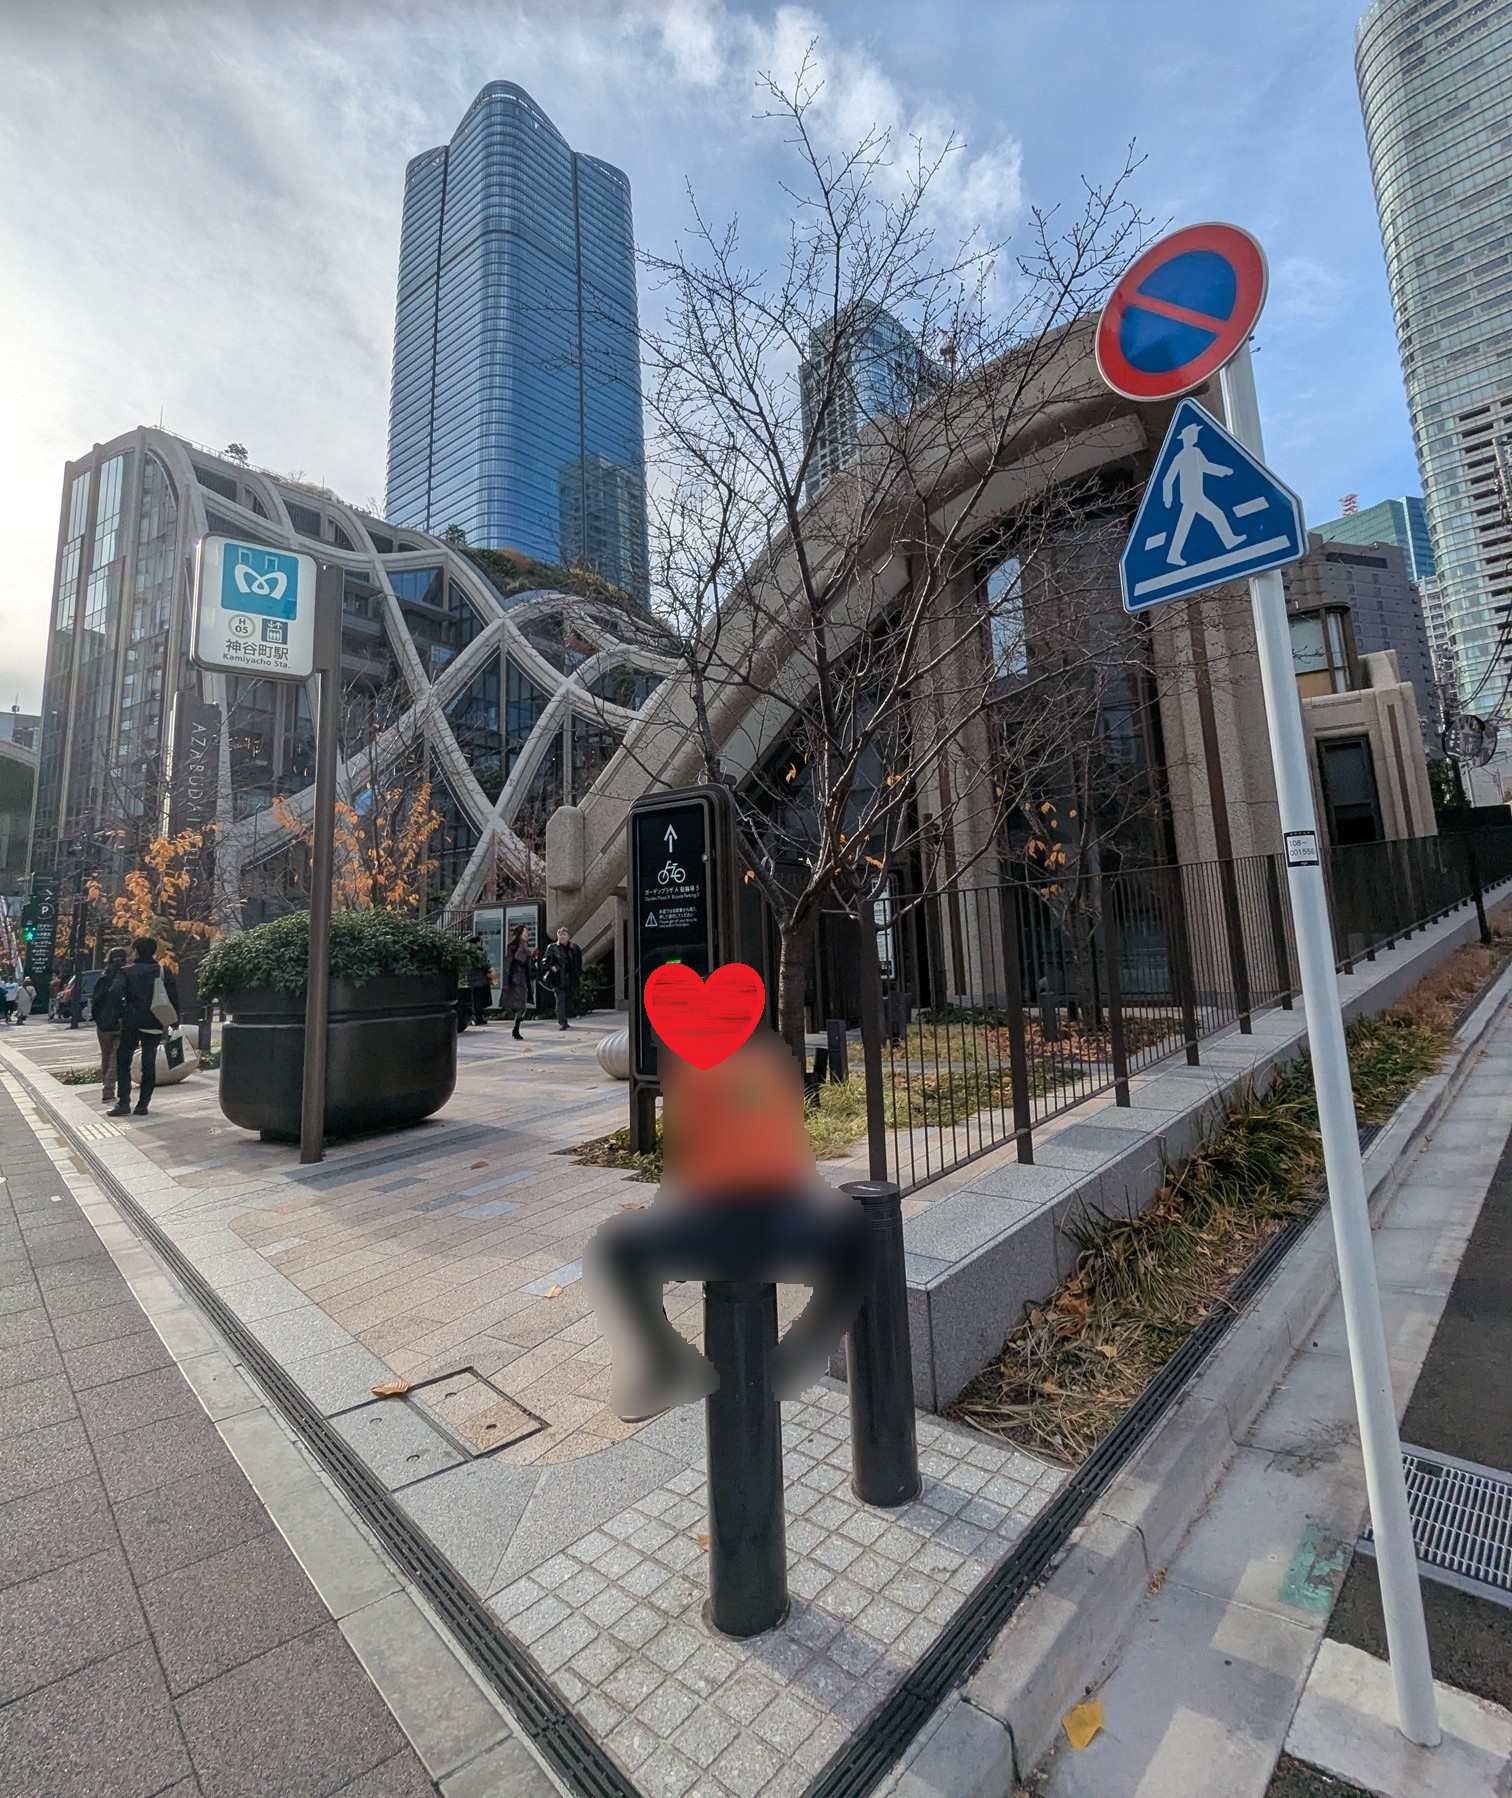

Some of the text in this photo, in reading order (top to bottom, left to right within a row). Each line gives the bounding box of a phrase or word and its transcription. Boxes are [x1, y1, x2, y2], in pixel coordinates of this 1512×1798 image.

[238, 618, 246, 626] H
[234, 625, 248, 634] 05
[225, 639, 289, 661] 神谷町駅
[223, 653, 291, 669] Kamiyacho Sta.
[41, 905, 49, 914] P
